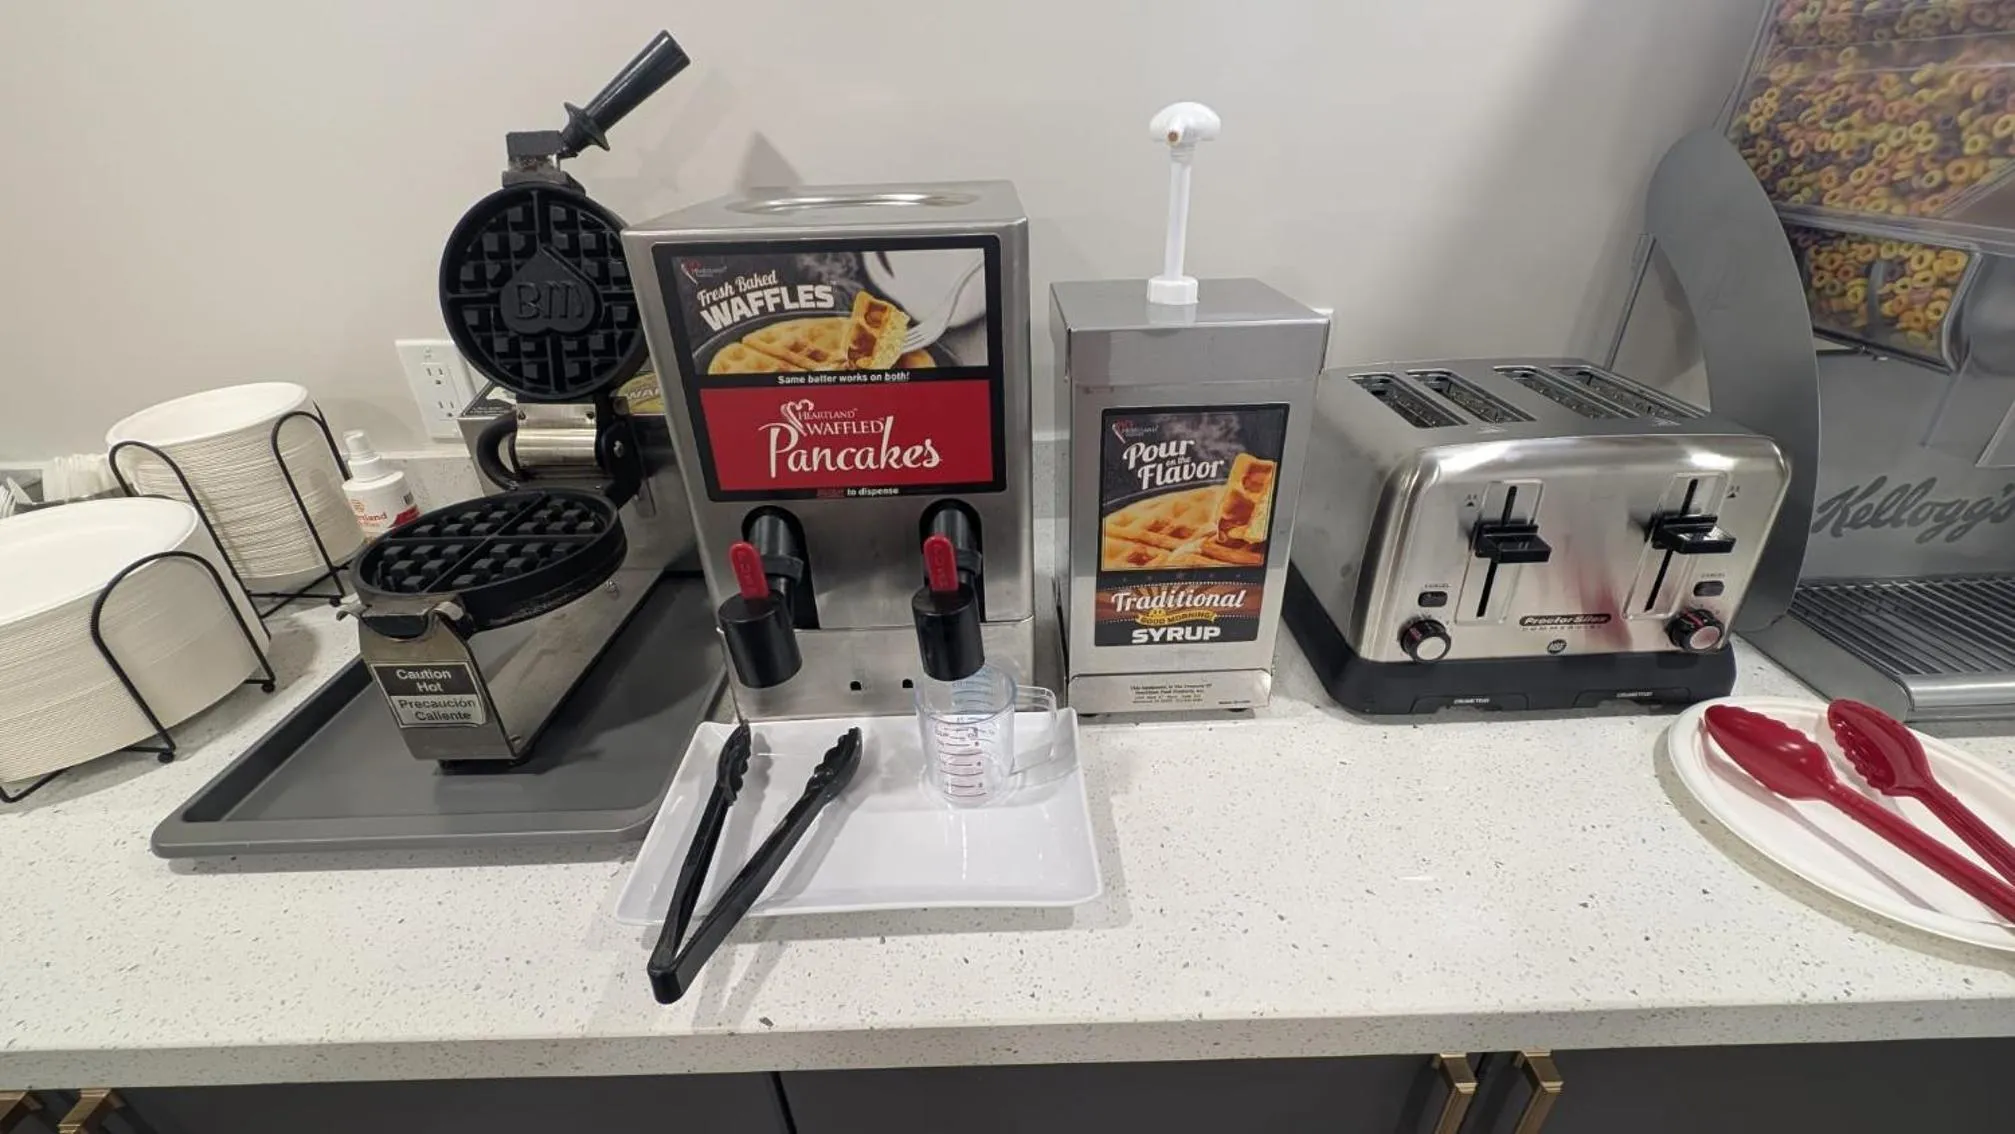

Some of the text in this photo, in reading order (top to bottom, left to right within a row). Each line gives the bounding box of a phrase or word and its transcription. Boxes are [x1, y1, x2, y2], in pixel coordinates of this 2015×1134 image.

[697, 281, 735, 307] Fresh
[735, 269, 778, 292] Baked
[700, 284, 835, 332] WAFFLES
[777, 371, 910, 385] Same batter works on both!
[806, 420, 884, 435] WAFFLED
[758, 415, 942, 479] Pancakes
[1122, 439, 1195, 471] Pour
[1137, 459, 1225, 490] Flavor
[847, 487, 857, 496] to
[858, 487, 899, 496] dispense
[1811, 475, 2015, 544] Kellogg's
[1111, 589, 1247, 612] Traditional
[1131, 625, 1221, 644] SYRUP
[395, 668, 452, 680] Caution
[416, 682, 444, 692] Hot
[398, 698, 476, 709] Precaución
[414, 711, 472, 721] Caliente
